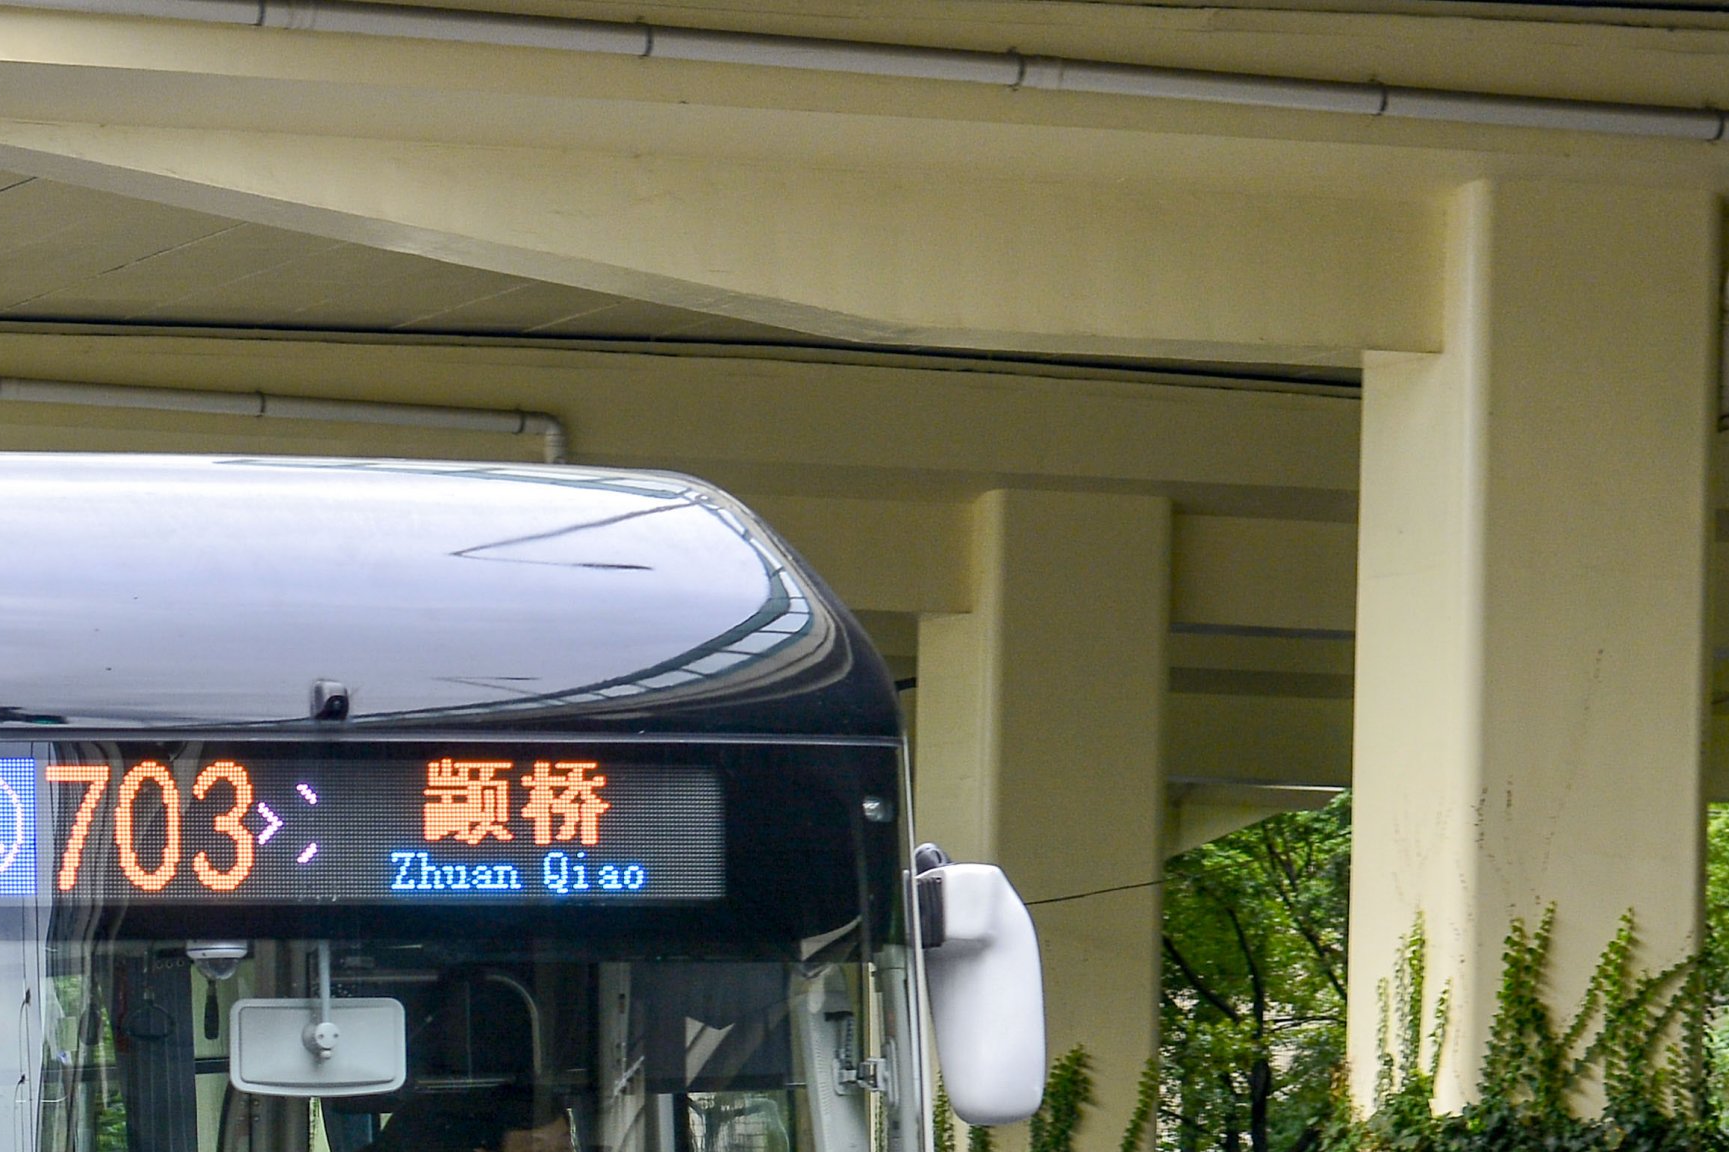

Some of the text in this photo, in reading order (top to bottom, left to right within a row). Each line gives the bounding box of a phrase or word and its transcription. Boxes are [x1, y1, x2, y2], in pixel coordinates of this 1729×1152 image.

[44, 760, 255, 892] 703
[423, 757, 613, 845] 颛桥
[390, 852, 647, 894] Zhuan Qiao
